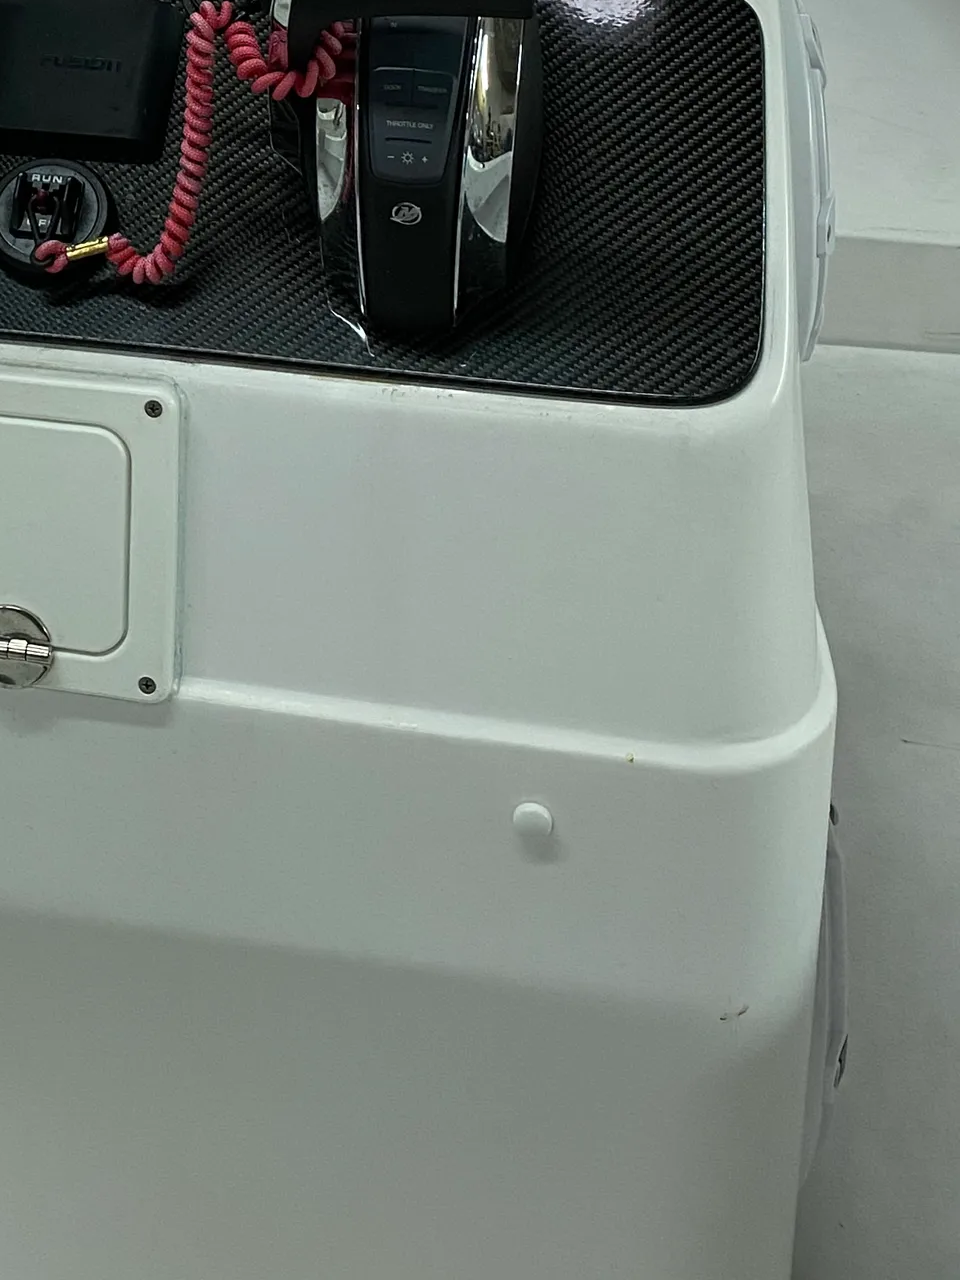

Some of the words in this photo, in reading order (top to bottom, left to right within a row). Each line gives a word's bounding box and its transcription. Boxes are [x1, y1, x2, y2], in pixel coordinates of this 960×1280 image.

[40, 53, 122, 73] FUSION
[386, 119, 417, 128] THROTTLE
[417, 122, 434, 130] ONLY
[31, 173, 63, 184] RUN
